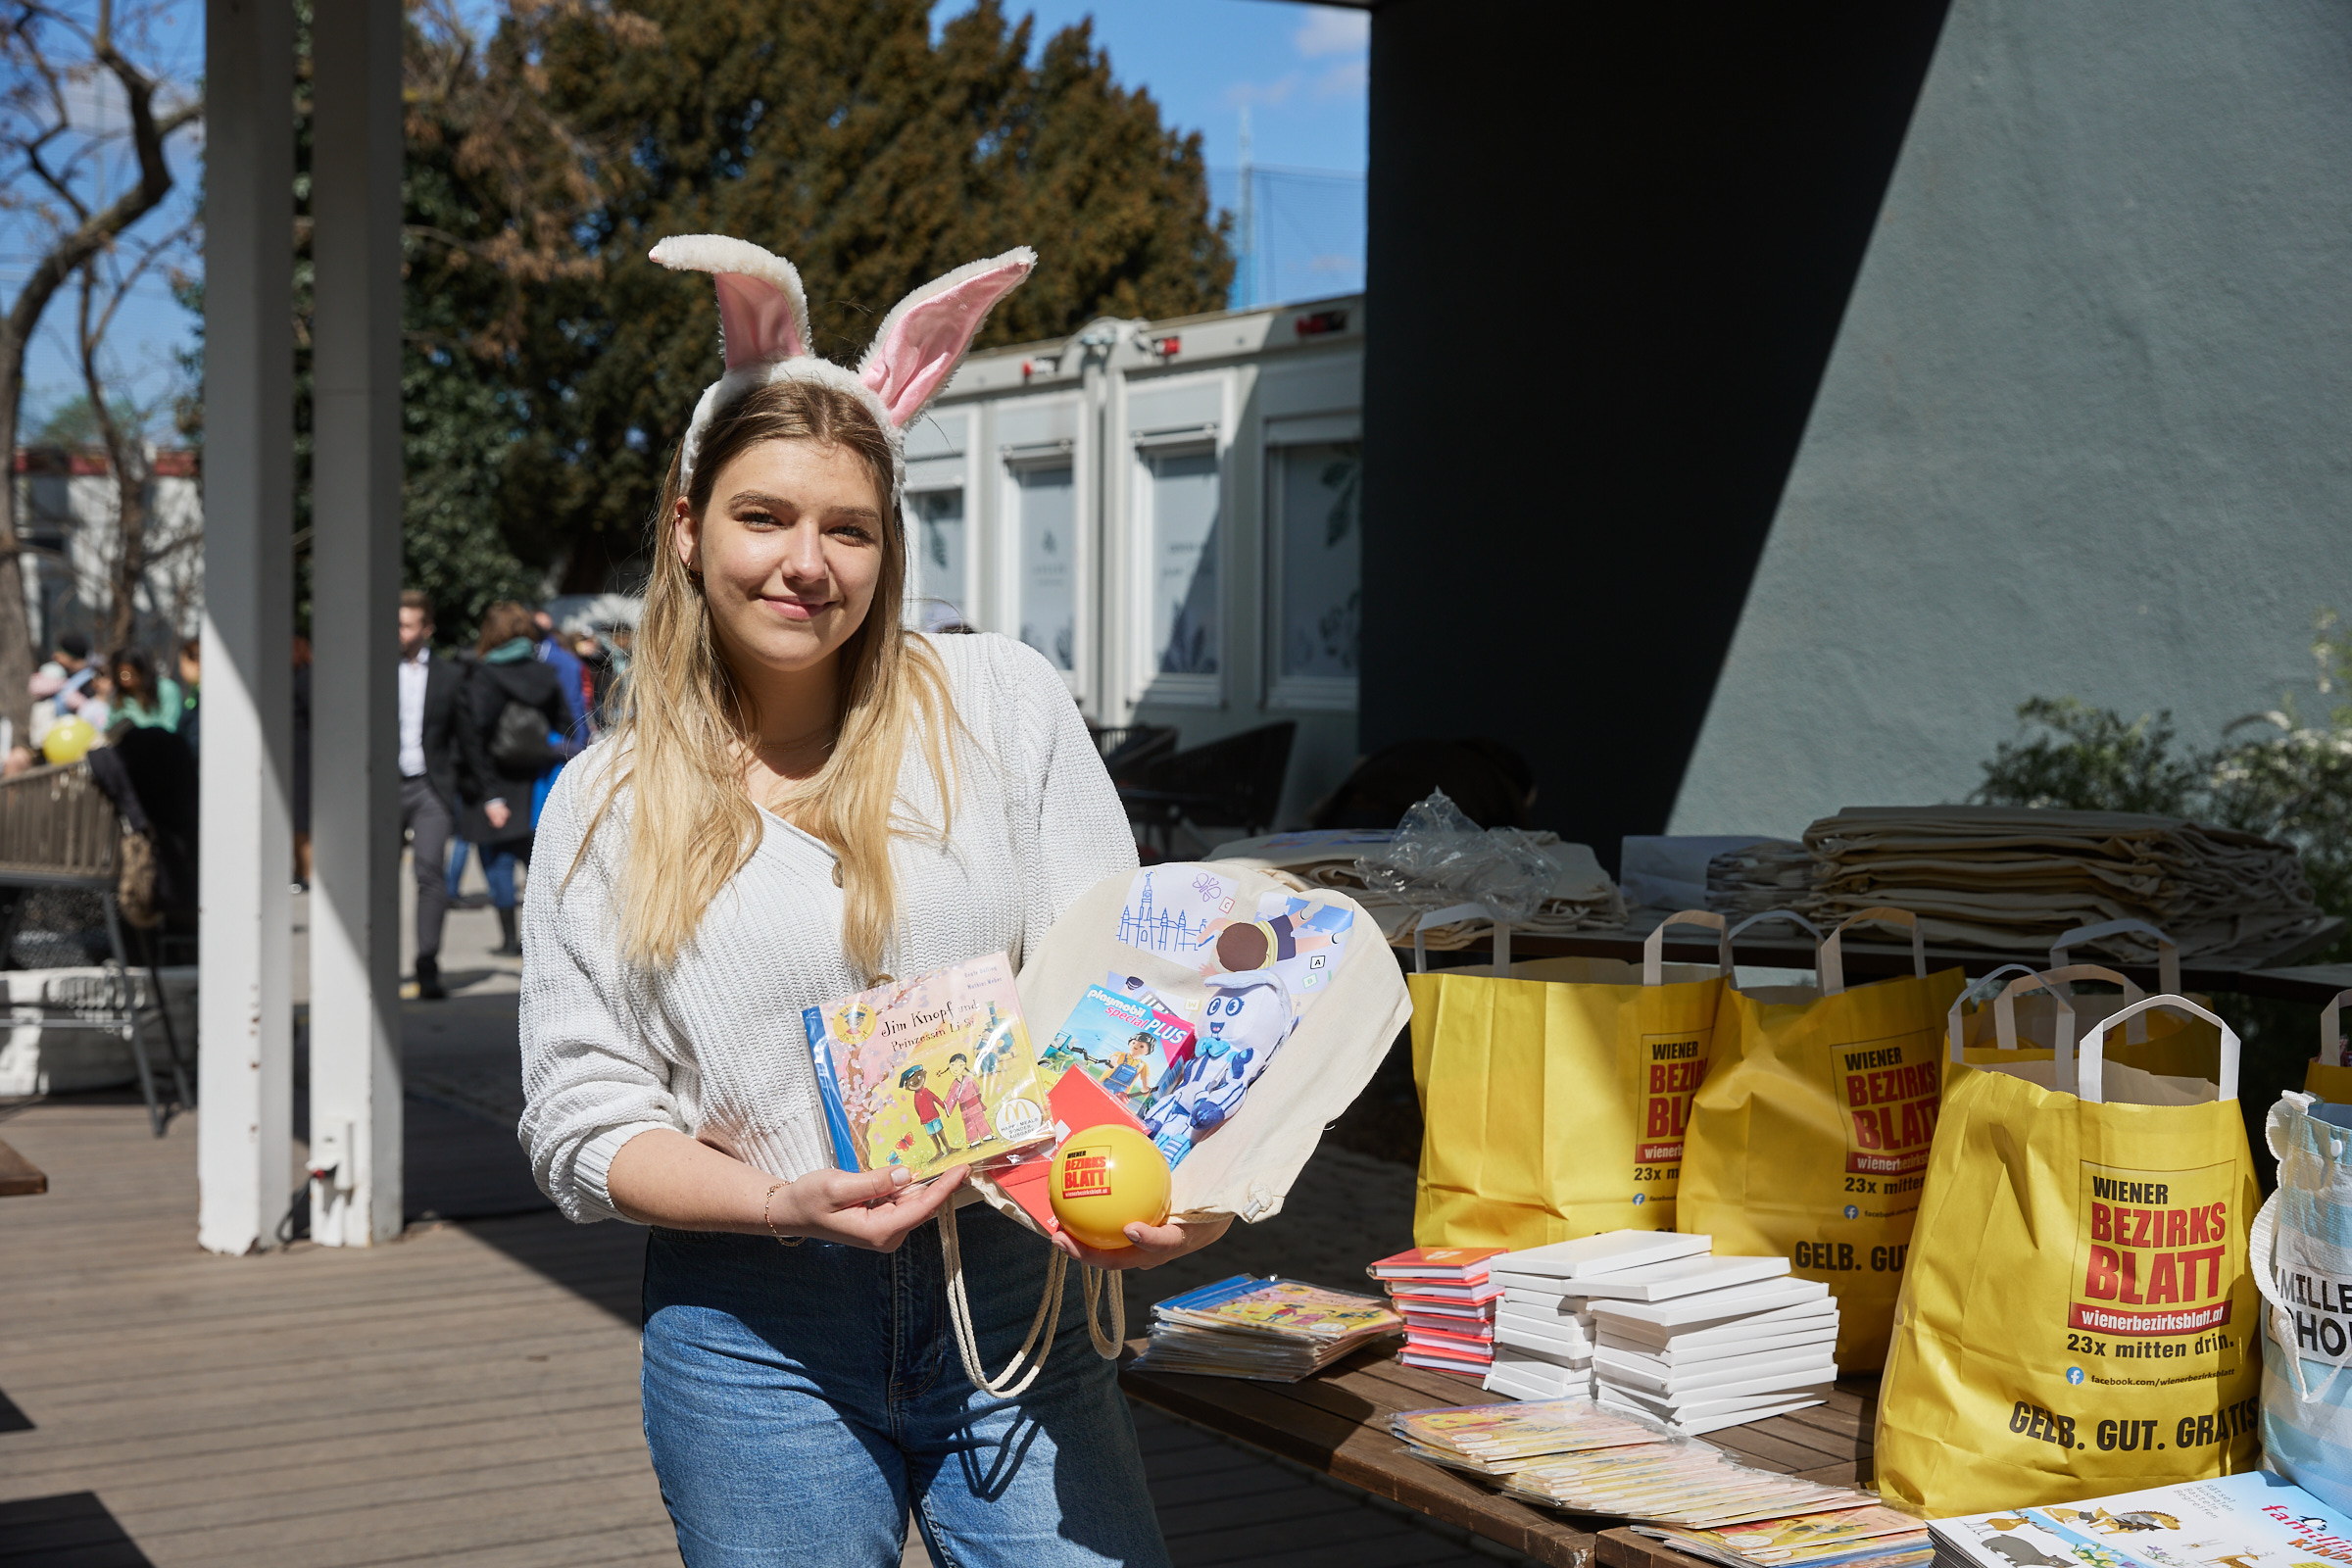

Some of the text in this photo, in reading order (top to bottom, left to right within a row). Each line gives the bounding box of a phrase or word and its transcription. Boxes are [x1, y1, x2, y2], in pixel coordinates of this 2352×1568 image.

[881, 999, 979, 1038] Jim Knopf und
[1087, 989, 1147, 1018] playmobil
[890, 1028, 946, 1053] Prinzessin
[950, 1021, 960, 1033] Li
[1104, 1006, 1189, 1045] special PLUS
[1652, 1041, 1699, 1060] WIENER
[1844, 1047, 1903, 1071] WIENER
[1649, 1057, 1708, 1095] BEZIR
[1846, 1059, 1937, 1107] BEZIRKS
[1851, 1096, 1939, 1152] BLATT
[1065, 1155, 1106, 1172] BEZIRKS
[1634, 1167, 1661, 1181] 23x
[1064, 1169, 1106, 1189] BLATT
[1844, 1177, 1878, 1195] 23x
[2092, 1176, 2169, 1205] WIENER
[2091, 1200, 2227, 1249] BEZIRKS
[1795, 1240, 1911, 1273] GELB. GU
[2084, 1244, 2226, 1305] BLATT
[2276, 1265, 2352, 1314] MILLE
[2082, 1305, 2225, 1333] wienerbezirksblatt.at
[2067, 1333, 2235, 1359] 23x mitten drin.
[2091, 1367, 2235, 1388] facebook.com/wienerbezirksblatt
[2009, 1396, 2259, 1452] GELB. GUT. GRATIS
